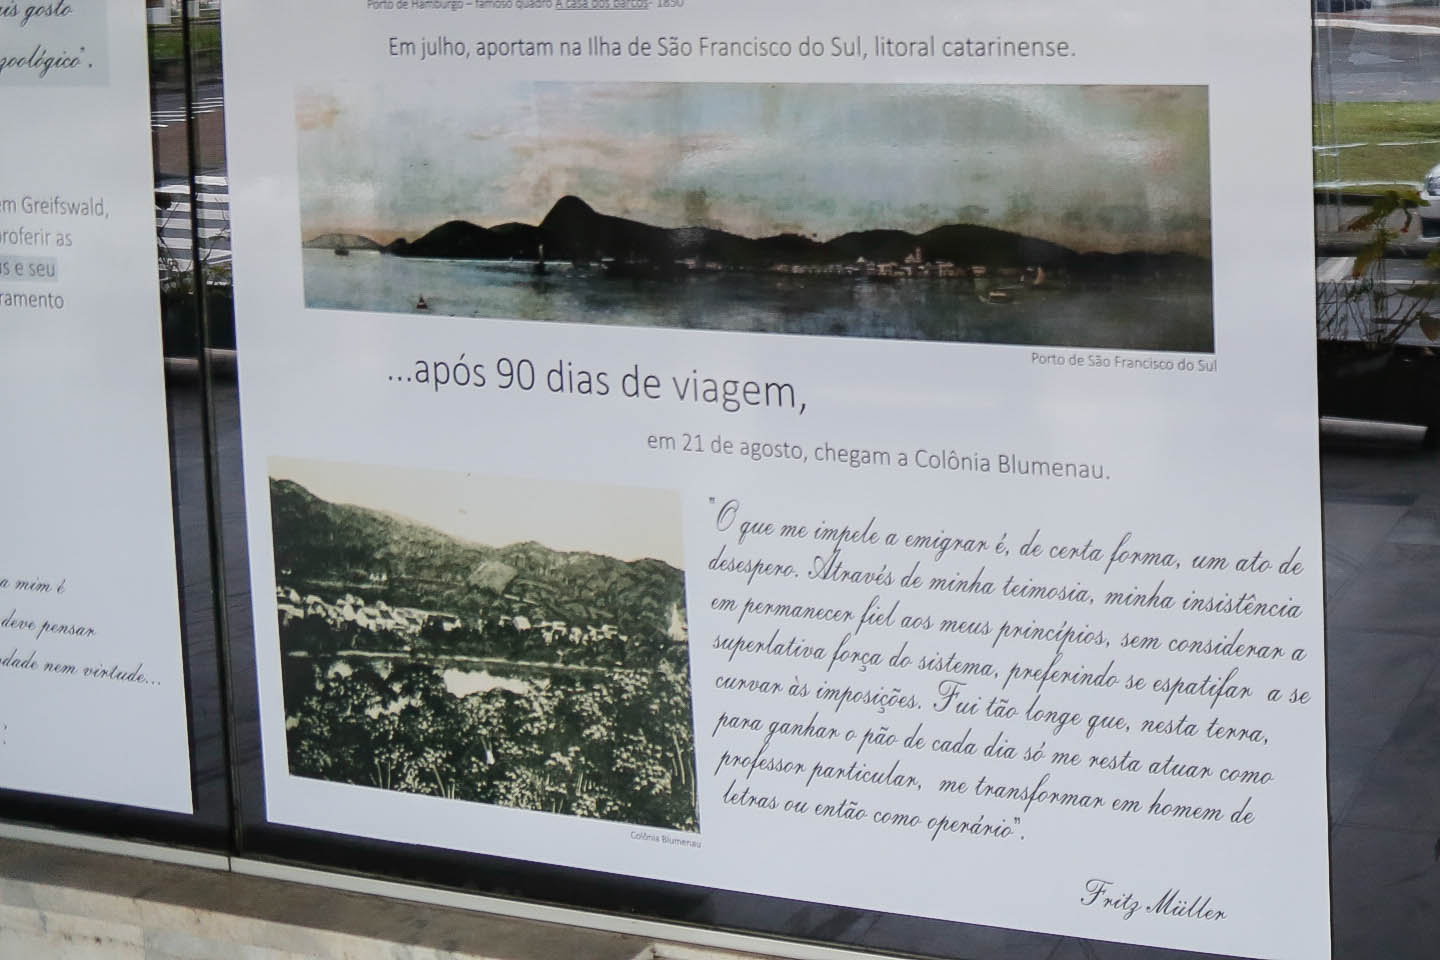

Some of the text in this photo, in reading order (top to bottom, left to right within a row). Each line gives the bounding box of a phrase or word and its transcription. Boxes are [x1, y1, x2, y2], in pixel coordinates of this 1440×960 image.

[420, 34, 1076, 61] julho, aportam Ilha São Francisco Sul, litoral catarinense.
[22, 196, 110, 220] Greifswald,
[29, 262, 55, 278] seu
[1031, 352, 1217, 373] Porto São Francisco Sul
[546, 359, 610, 396] dias
[672, 369, 806, 416] viagem,
[740, 440, 1110, 480] agosto, chegam Colônia Blumenau.
[737, 517, 1273, 575] que impele emigrar certa forma, ato
[15, 576, 52, 593] mim
[708, 544, 1303, 619] desespero. Através minha teimosia, minha insistência
[36, 620, 96, 641] pensar
[738, 594, 1286, 660] permanecer fiel aos meus princípios, sem considerar
[44, 660, 78, 675] nem
[712, 628, 1254, 710] superlativa força sistema, preferindo espatifar
[715, 675, 1268, 746] curvar imposições. Fui tão longe que, nesta terra,
[711, 711, 1275, 785] para ganhar pão cada dia resta atuar como
[713, 739, 1225, 821] professor particular, transformar homem
[722, 778, 780, 810] letras
[814, 798, 868, 821] então
[873, 811, 921, 829] como
[1080, 878, 1228, 921] Fritz Müller
